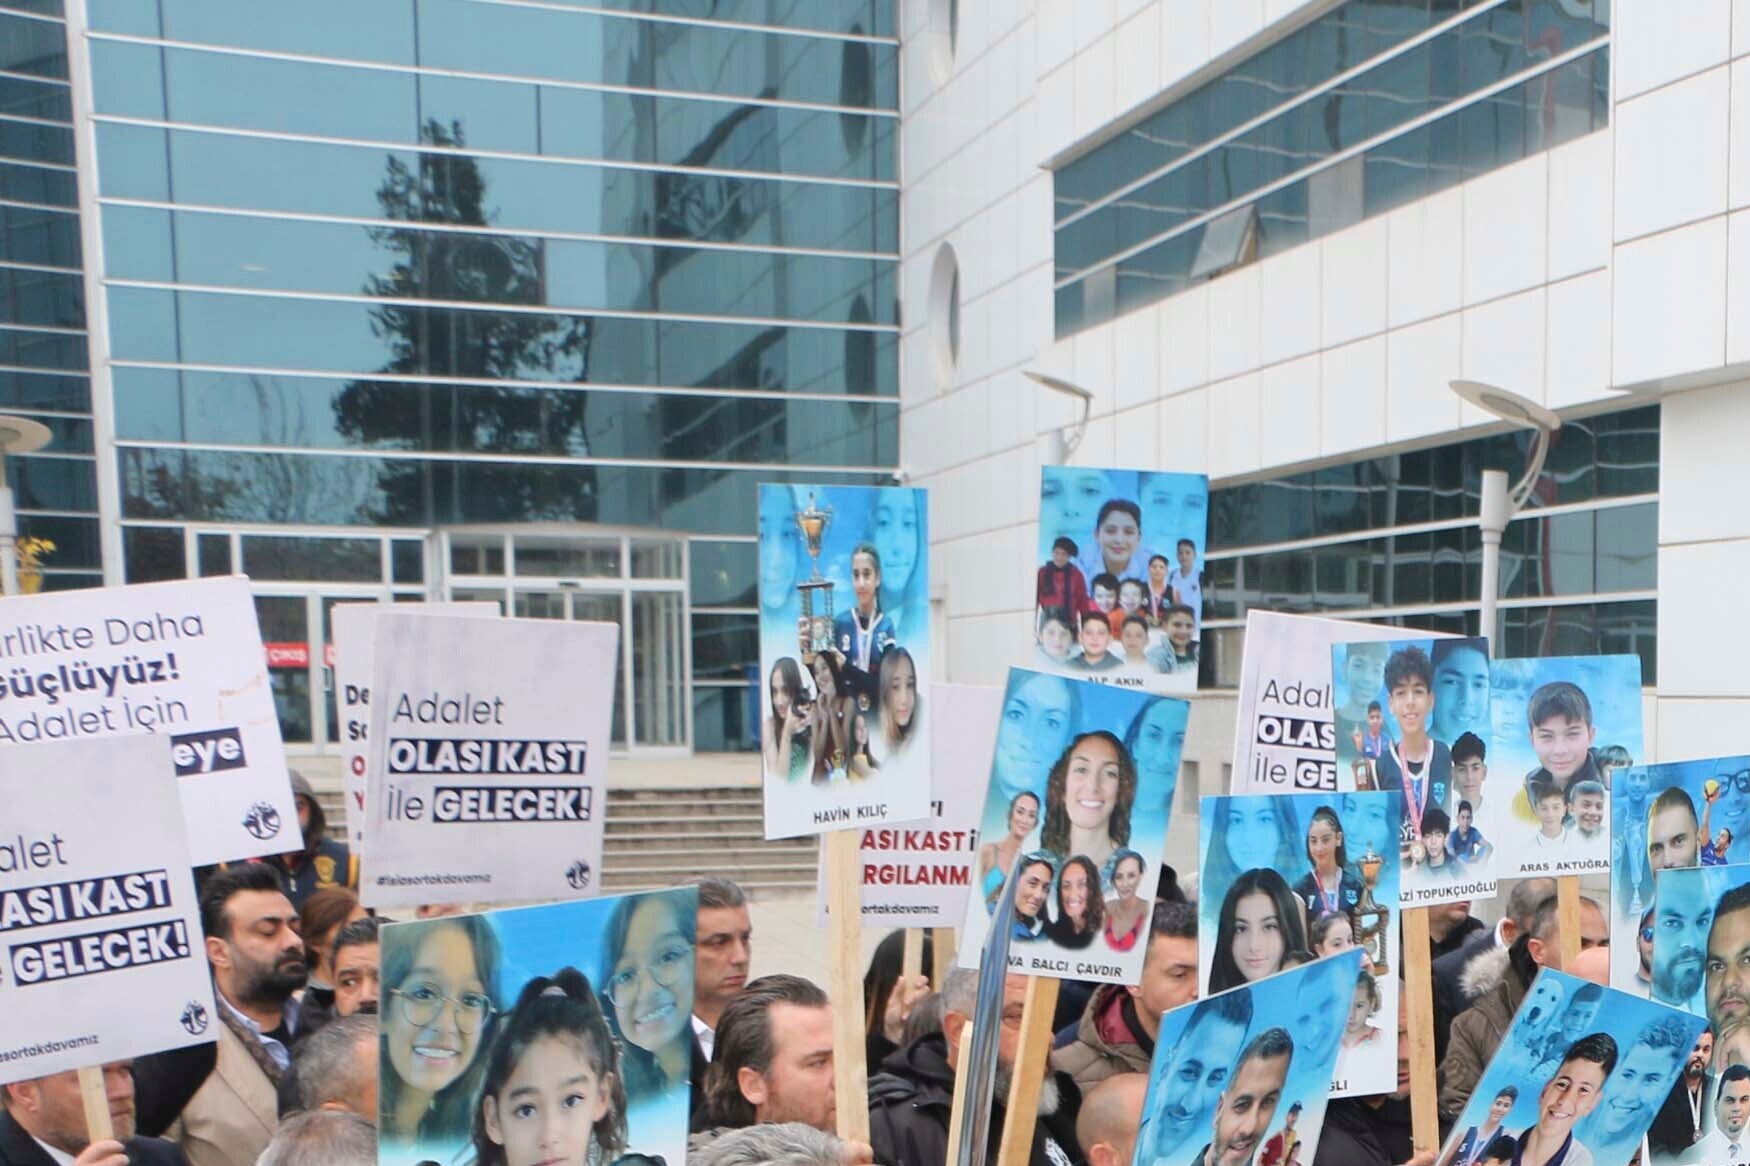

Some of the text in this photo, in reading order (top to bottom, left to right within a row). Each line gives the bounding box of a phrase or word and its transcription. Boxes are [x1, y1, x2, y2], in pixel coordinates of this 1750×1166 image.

[0, 612, 205, 658] rlikte Daha
[393, 692, 504, 725] Adalet
[1262, 678, 1333, 710] Adal
[1257, 718, 1336, 749] OLAS
[389, 740, 491, 772] OLASI
[497, 742, 588, 773] KAST
[433, 787, 592, 821] GELECEK!
[813, 804, 888, 824] HAVİN KILIÇ
[0, 833, 68, 872] alet
[860, 830, 898, 850] ASI
[904, 830, 965, 851] KAST
[863, 864, 971, 886] RGILANM
[1520, 863, 1550, 873] ARAS
[0, 871, 168, 929] ASI KAST
[1417, 882, 1497, 899] TOPUKÇUOĞLU
[861, 904, 939, 914] ortakdavamız
[13, 921, 189, 983] GELECEK!
[1032, 958, 1069, 971] BALCI
[1076, 962, 1123, 978] ÇAVDIR
